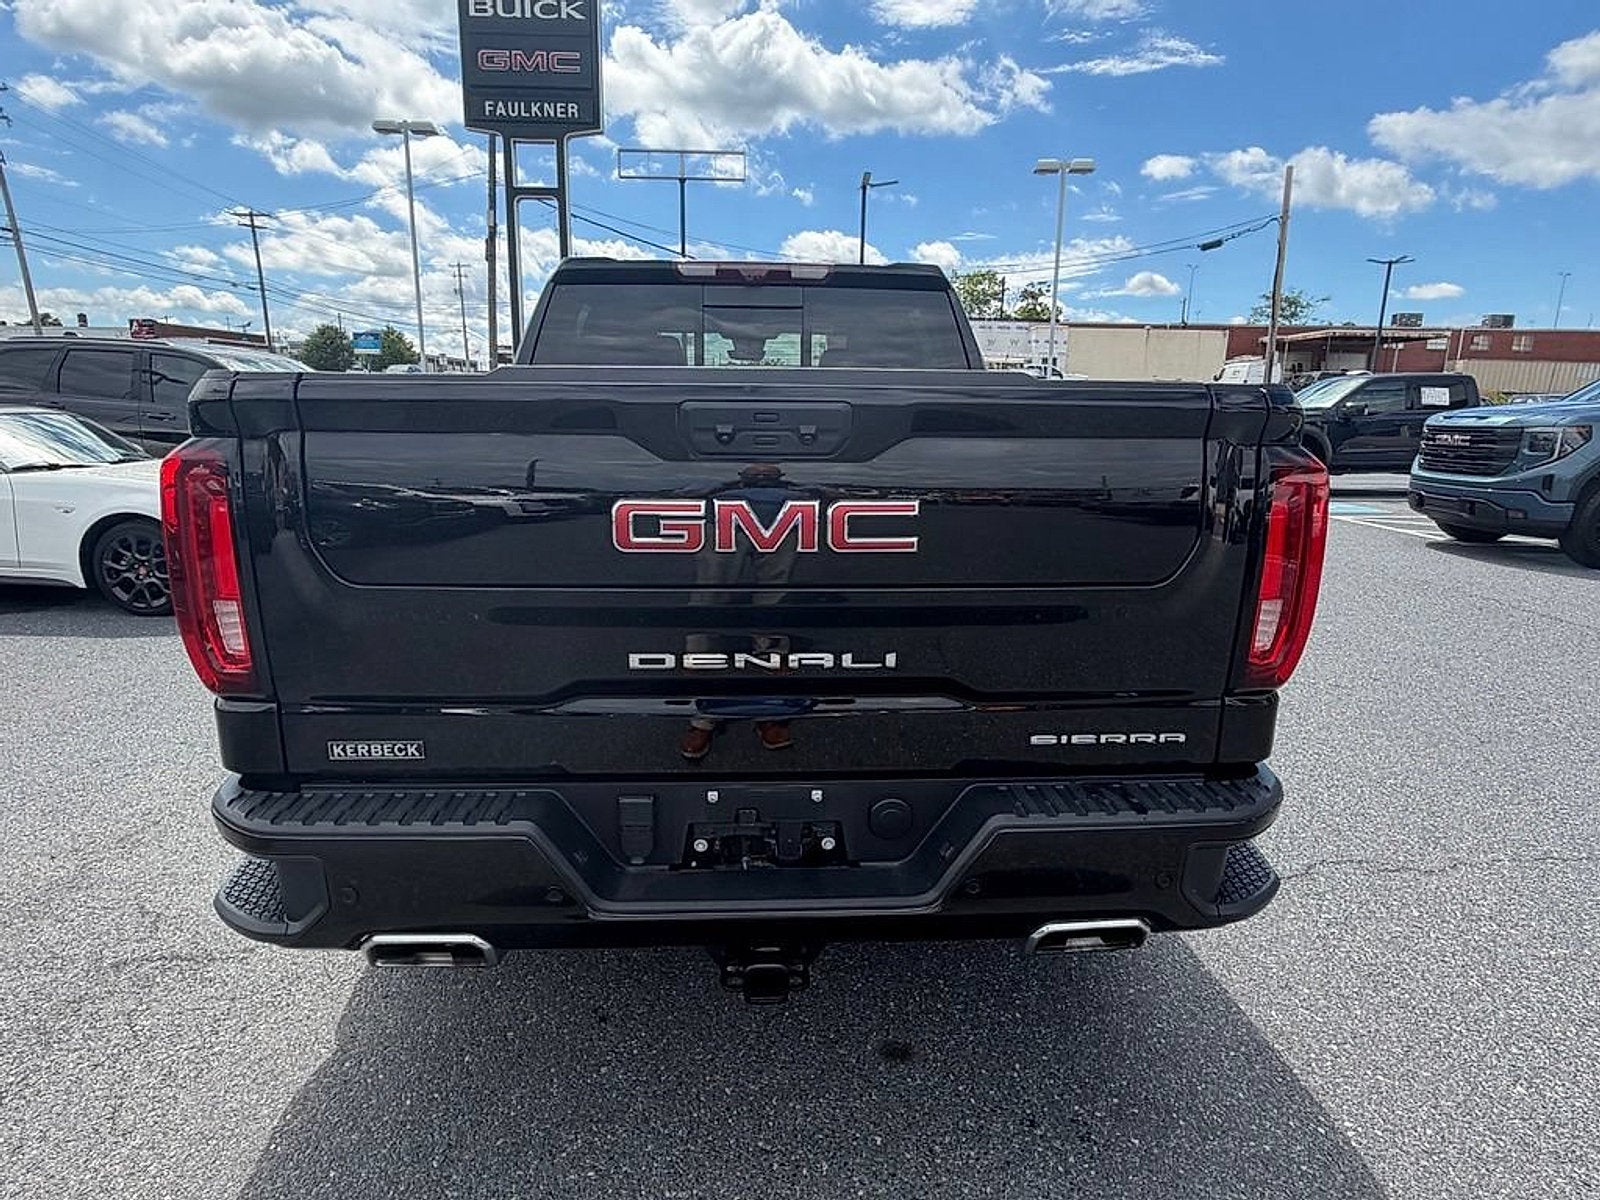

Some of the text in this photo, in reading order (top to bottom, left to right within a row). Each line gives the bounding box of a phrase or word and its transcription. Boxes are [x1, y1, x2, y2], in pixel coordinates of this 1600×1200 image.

[477, 49, 581, 73] GMC
[484, 100, 578, 119] FAULKNER
[612, 499, 919, 553] GMC
[628, 652, 897, 670] DENALI
[1030, 733, 1187, 745] SIERRA
[332, 743, 420, 757] KERBECK
